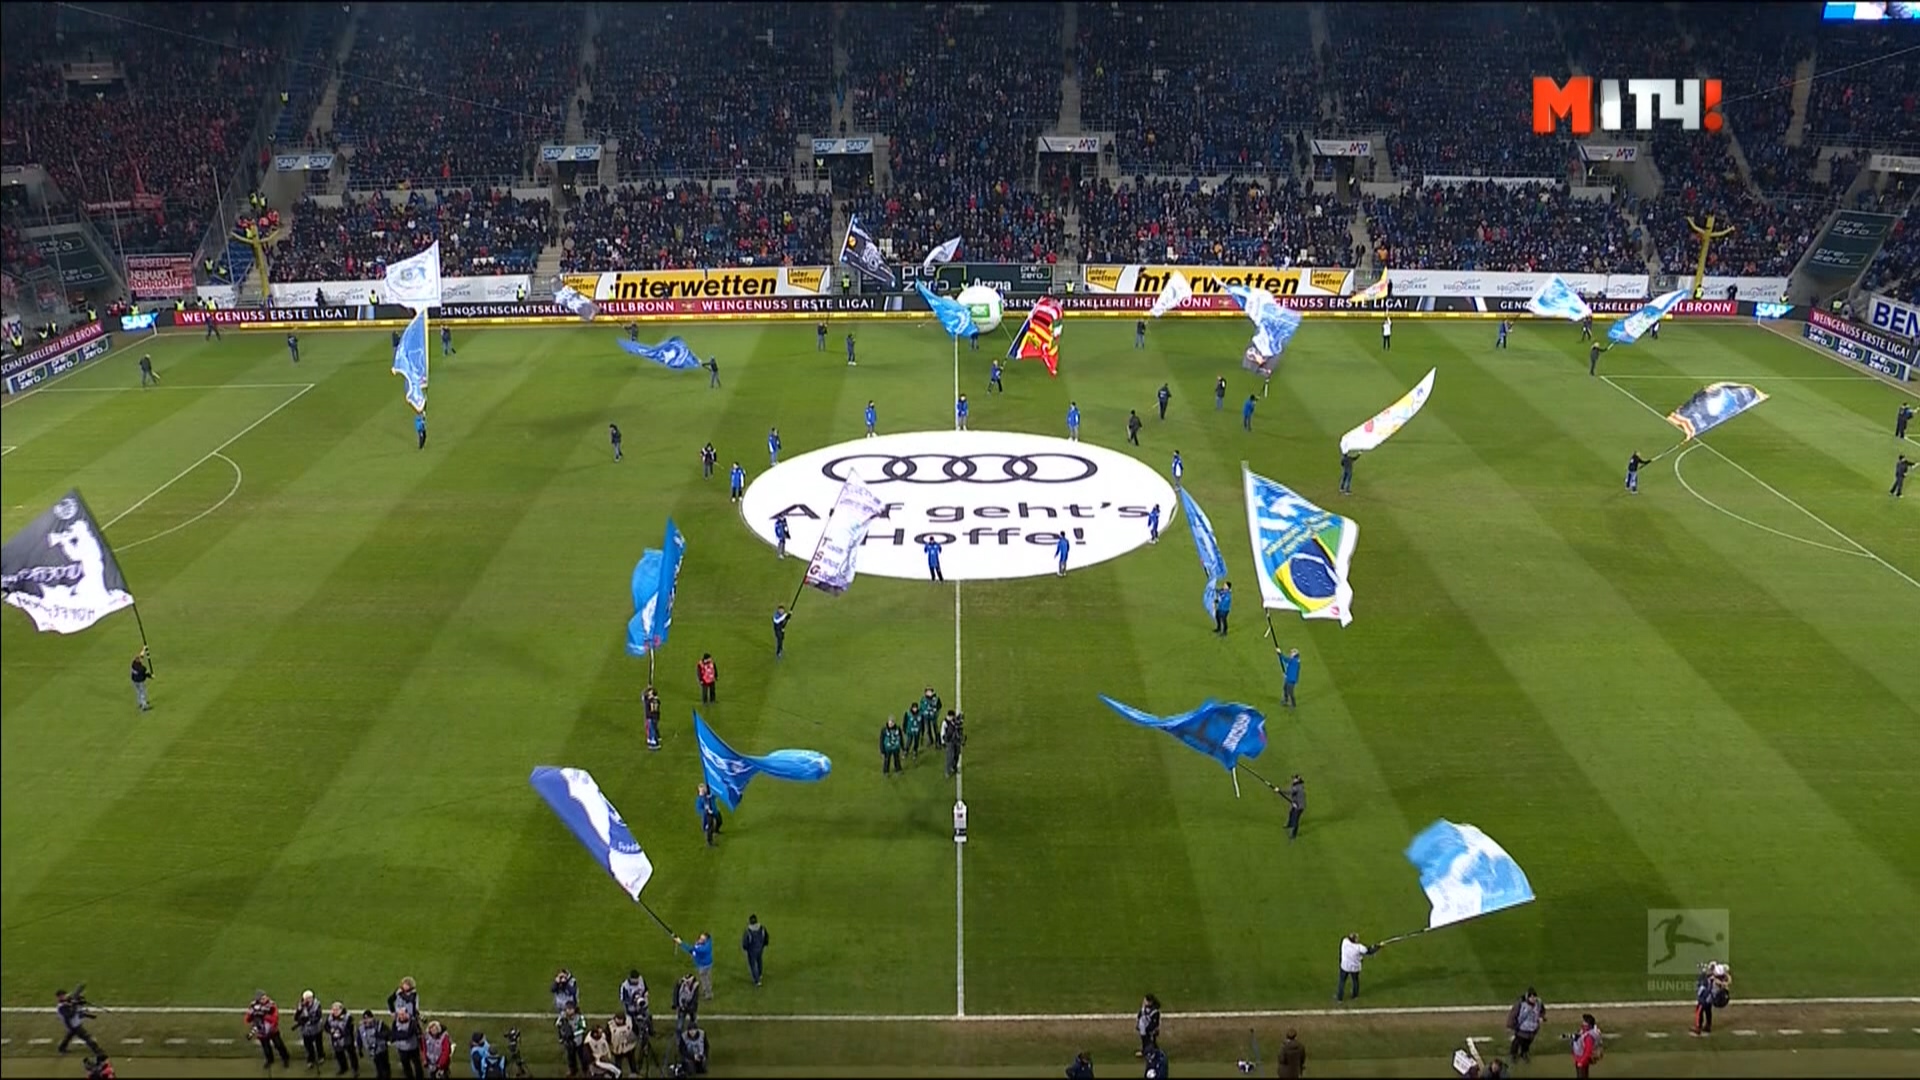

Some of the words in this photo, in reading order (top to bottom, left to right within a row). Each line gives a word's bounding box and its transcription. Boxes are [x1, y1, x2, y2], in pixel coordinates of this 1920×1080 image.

[814, 141, 833, 151] SAP
[847, 140, 865, 150] SAP
[543, 148, 564, 159] SAP
[575, 147, 594, 158] SAP
[277, 158, 297, 169] SAP
[309, 156, 328, 167] SAP
[902, 265, 936, 280] pre
[974, 277, 1011, 291] Arena
[1134, 266, 1299, 294] intrwetten
[615, 274, 777, 300] interwetten
[598, 300, 675, 314] HEILBRONN
[702, 299, 788, 311] WEINGENUSS
[793, 298, 833, 310] ERSTE
[838, 298, 874, 309] LIGA!
[1374, 299, 1408, 309] LIGA!
[1756, 304, 1789, 317] SAP
[270, 309, 309, 321] ERSTE
[313, 308, 348, 320] LIGA!
[122, 315, 154, 330] SAP
[59, 324, 103, 349] HEILBRONN
[1809, 324, 1824, 337] pre
[1812, 311, 1860, 339] WEINGENUSS
[1860, 330, 1886, 350] ERSTE
[1886, 342, 1910, 359] LIGA!
[1808, 332, 1827, 346] zero
[1839, 339, 1855, 350] pre
[82, 341, 97, 354] pre
[84, 347, 103, 360] zero
[1837, 346, 1857, 359] zero
[51, 356, 66, 368] pre
[1869, 351, 1886, 364] pre
[53, 360, 73, 375] zero
[1868, 360, 1890, 374] zero
[17, 370, 33, 383] pre
[20, 375, 41, 390] zero
[926, 502, 1149, 523] geht's
[860, 528, 1086, 546] Hoffe!
